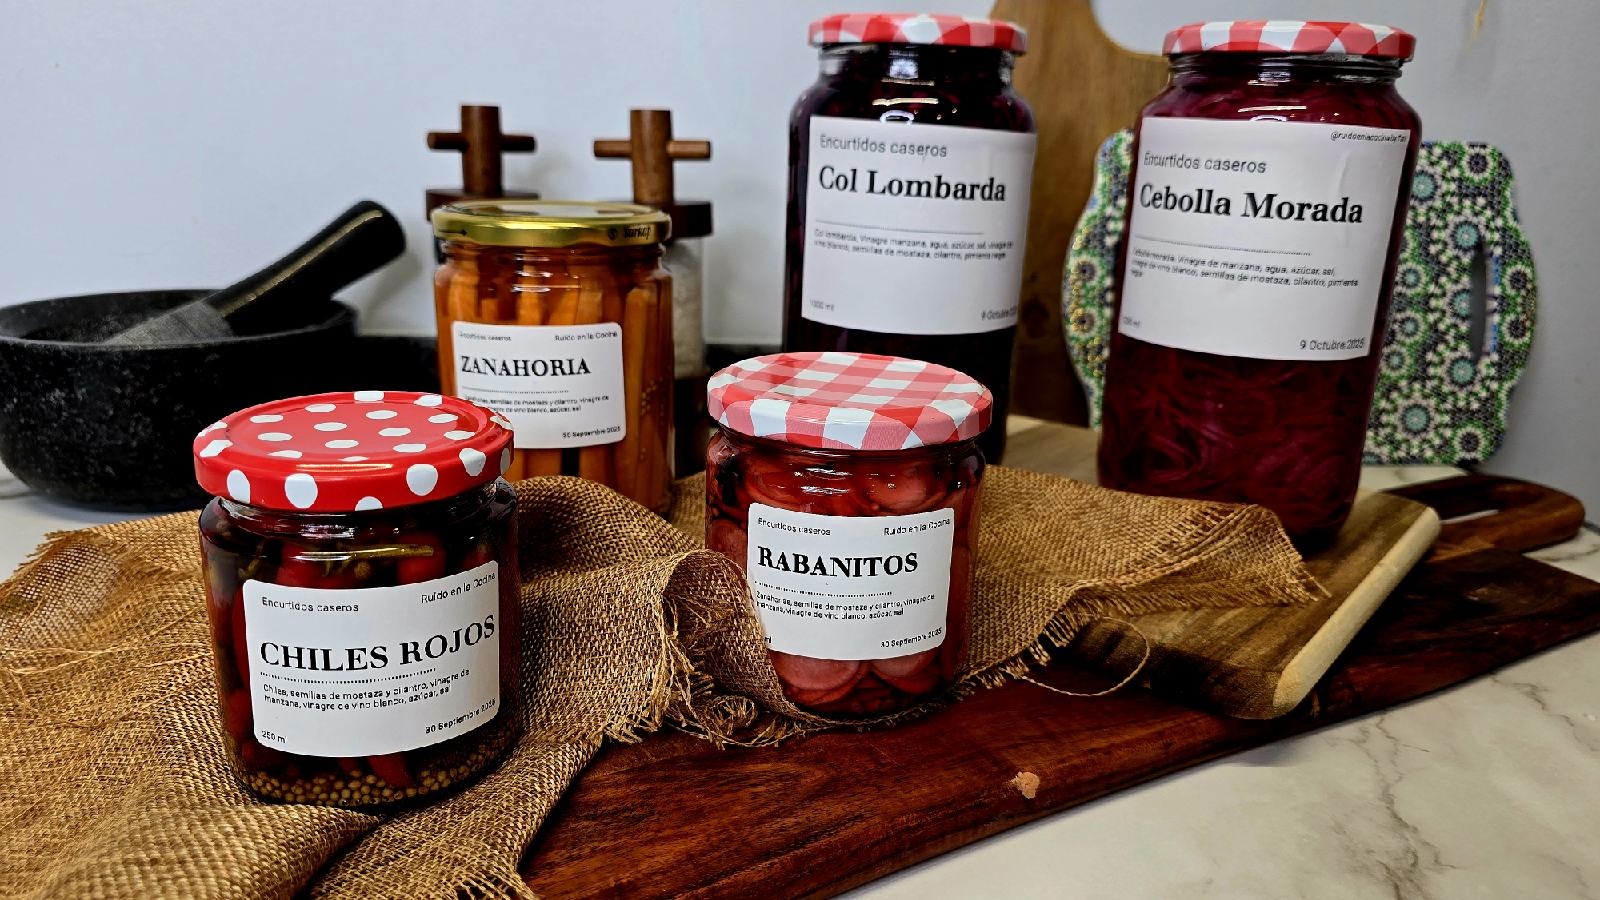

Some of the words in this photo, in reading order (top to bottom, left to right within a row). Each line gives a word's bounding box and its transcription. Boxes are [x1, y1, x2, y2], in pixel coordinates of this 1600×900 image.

[820, 134, 886, 153] Encurtidos
[889, 141, 948, 158] caseros
[1143, 150, 1201, 169] Encurtidos
[1204, 159, 1267, 174] caseros
[818, 164, 858, 193] Col
[866, 169, 1006, 201] Lombarda
[1140, 182, 1231, 216] Cebolla
[1240, 192, 1363, 223] Morada
[1207, 259, 1219, 268] de
[1200, 270, 1235, 281] semillas
[1236, 273, 1248, 282] de
[1299, 339, 1306, 350] 9
[1309, 339, 1346, 351] Octubre
[461, 355, 592, 377] ZANAHORIA
[757, 517, 797, 533] Encurtidos
[798, 527, 831, 536] caseros
[883, 525, 907, 536] Ruido
[908, 526, 919, 534] en
[919, 523, 927, 532] la
[928, 518, 951, 529] Cocina
[757, 545, 918, 577] RABANITOS
[450, 586, 462, 596] en
[463, 582, 471, 592] la
[473, 572, 496, 588] Cocina
[261, 596, 314, 612] Encurtidos
[317, 604, 359, 612] caseros
[786, 608, 812, 618] vinagre
[813, 611, 823, 619] de
[824, 612, 839, 620] vino
[893, 607, 904, 616] sal
[793, 600, 823, 610] semillas
[825, 602, 836, 611] de
[836, 603, 868, 612] mostaza
[869, 603, 874, 612] y
[260, 642, 389, 672] CHILES
[399, 614, 495, 666] ROJOS
[891, 633, 927, 648] Septiembre
[263, 683, 289, 697] Chiles,
[290, 690, 327, 700] semillas
[329, 691, 341, 700] de
[342, 690, 383, 700] mostaza
[385, 690, 391, 698] y
[393, 682, 429, 696] cilantro,
[429, 673, 459, 687] vinagre
[460, 668, 470, 678] de
[264, 694, 301, 709] manzana,
[302, 700, 335, 712] vinagre
[337, 702, 350, 711] de
[351, 700, 371, 710] vino
[373, 697, 407, 709] blanco,
[425, 725, 436, 735] 30
[438, 708, 480, 731] Septiembre
[261, 730, 276, 741] 250
